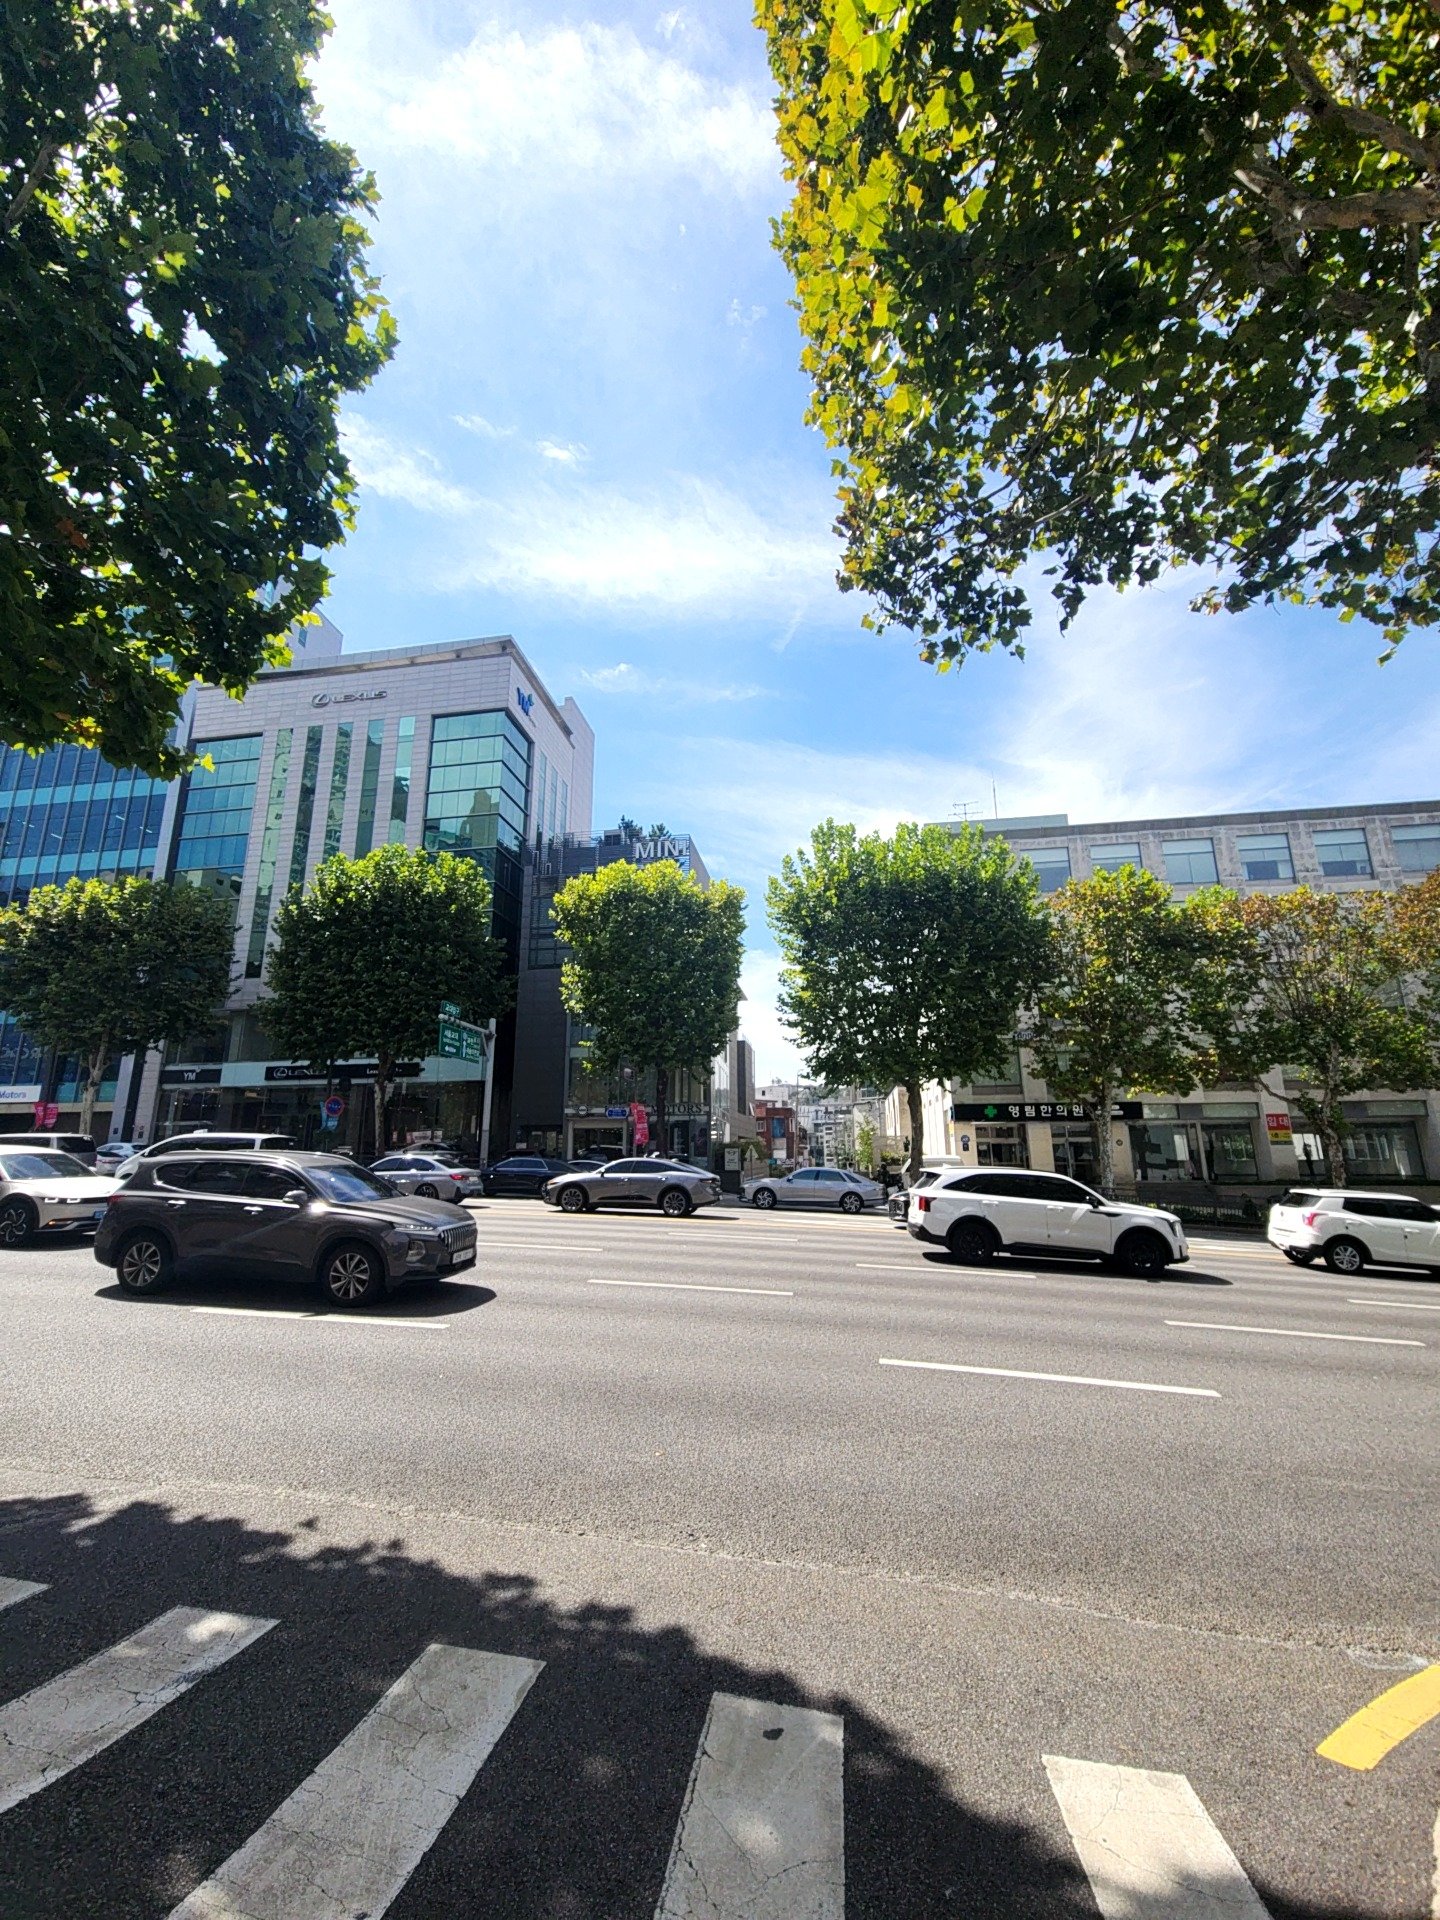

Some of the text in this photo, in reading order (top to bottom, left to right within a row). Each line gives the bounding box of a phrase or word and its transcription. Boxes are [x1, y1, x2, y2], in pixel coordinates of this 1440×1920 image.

[331, 690, 388, 704] LEXUS
[635, 840, 687, 858] MINI
[183, 1072, 197, 1081] YM
[1008, 1105, 1085, 1118] 영림한의원
[1267, 1116, 1290, 1127] 임대
